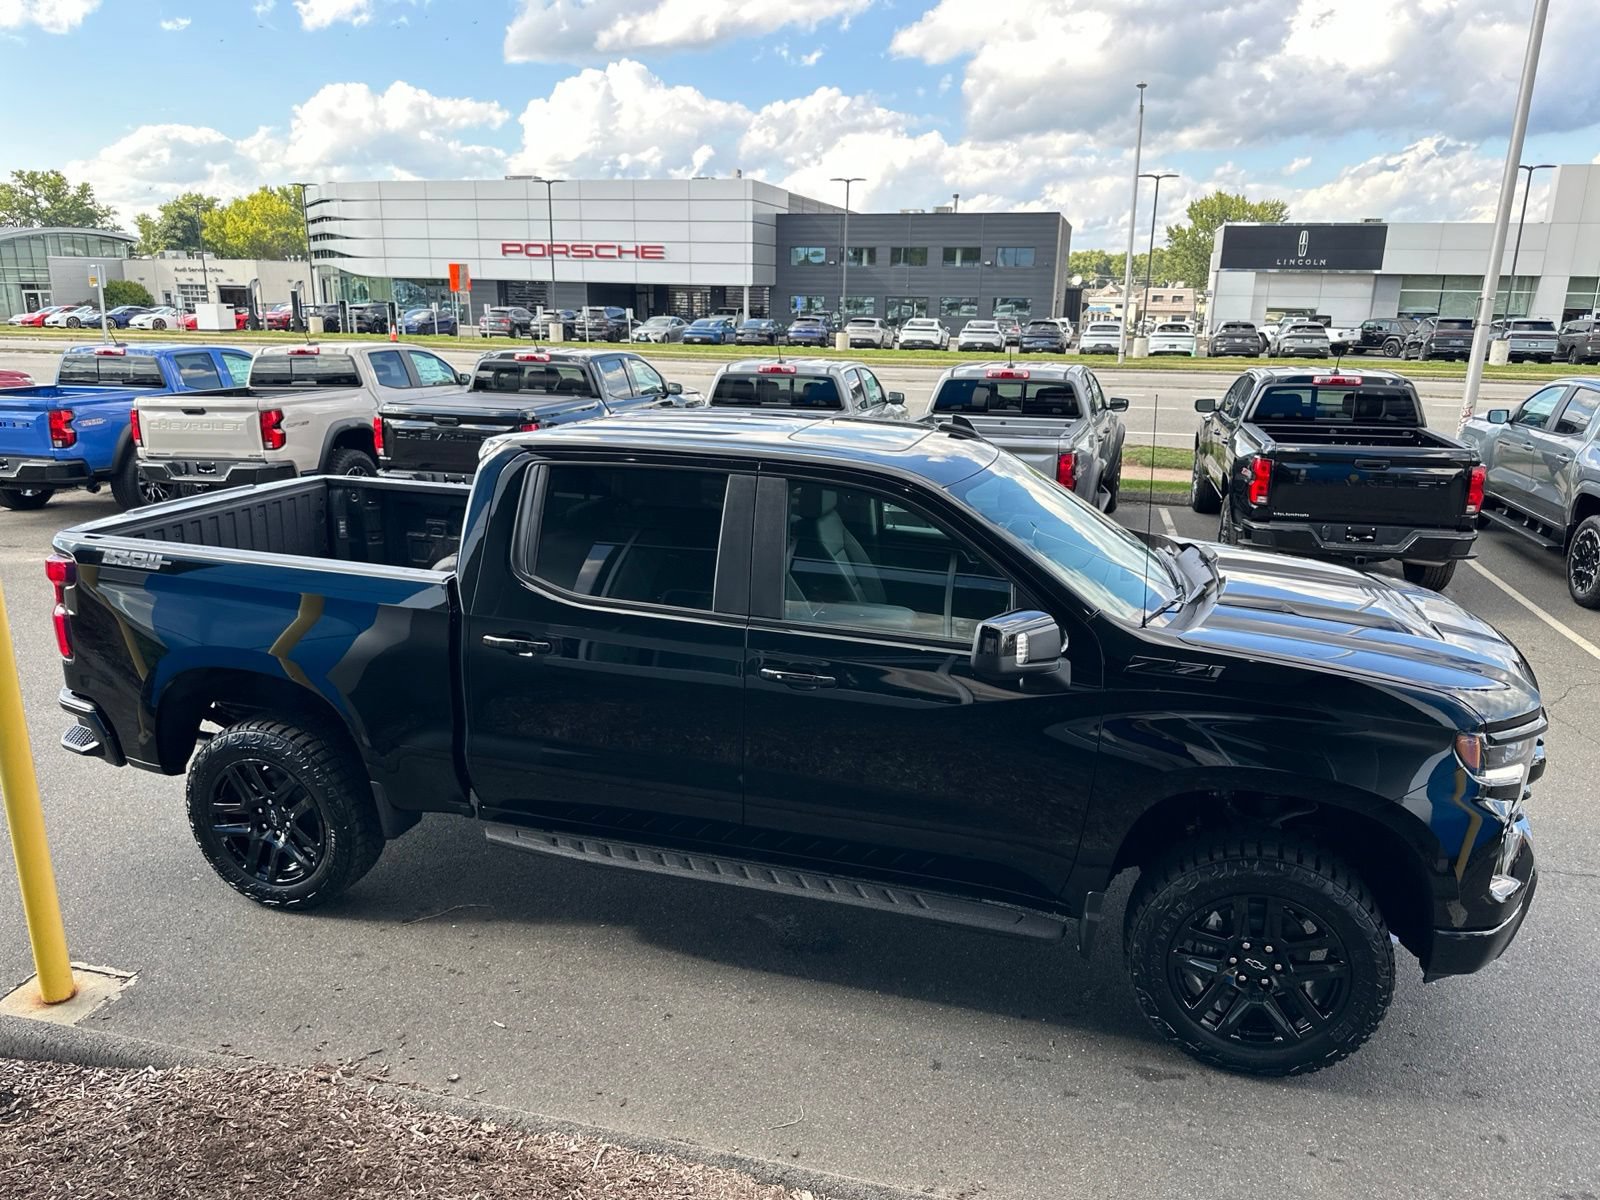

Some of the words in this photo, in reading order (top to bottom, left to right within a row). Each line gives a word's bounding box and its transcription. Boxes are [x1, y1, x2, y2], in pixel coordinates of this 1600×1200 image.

[501, 242, 666, 260] PORSCHE
[1276, 258, 1327, 266] LINCOLN
[149, 421, 244, 431] CHEVROLET
